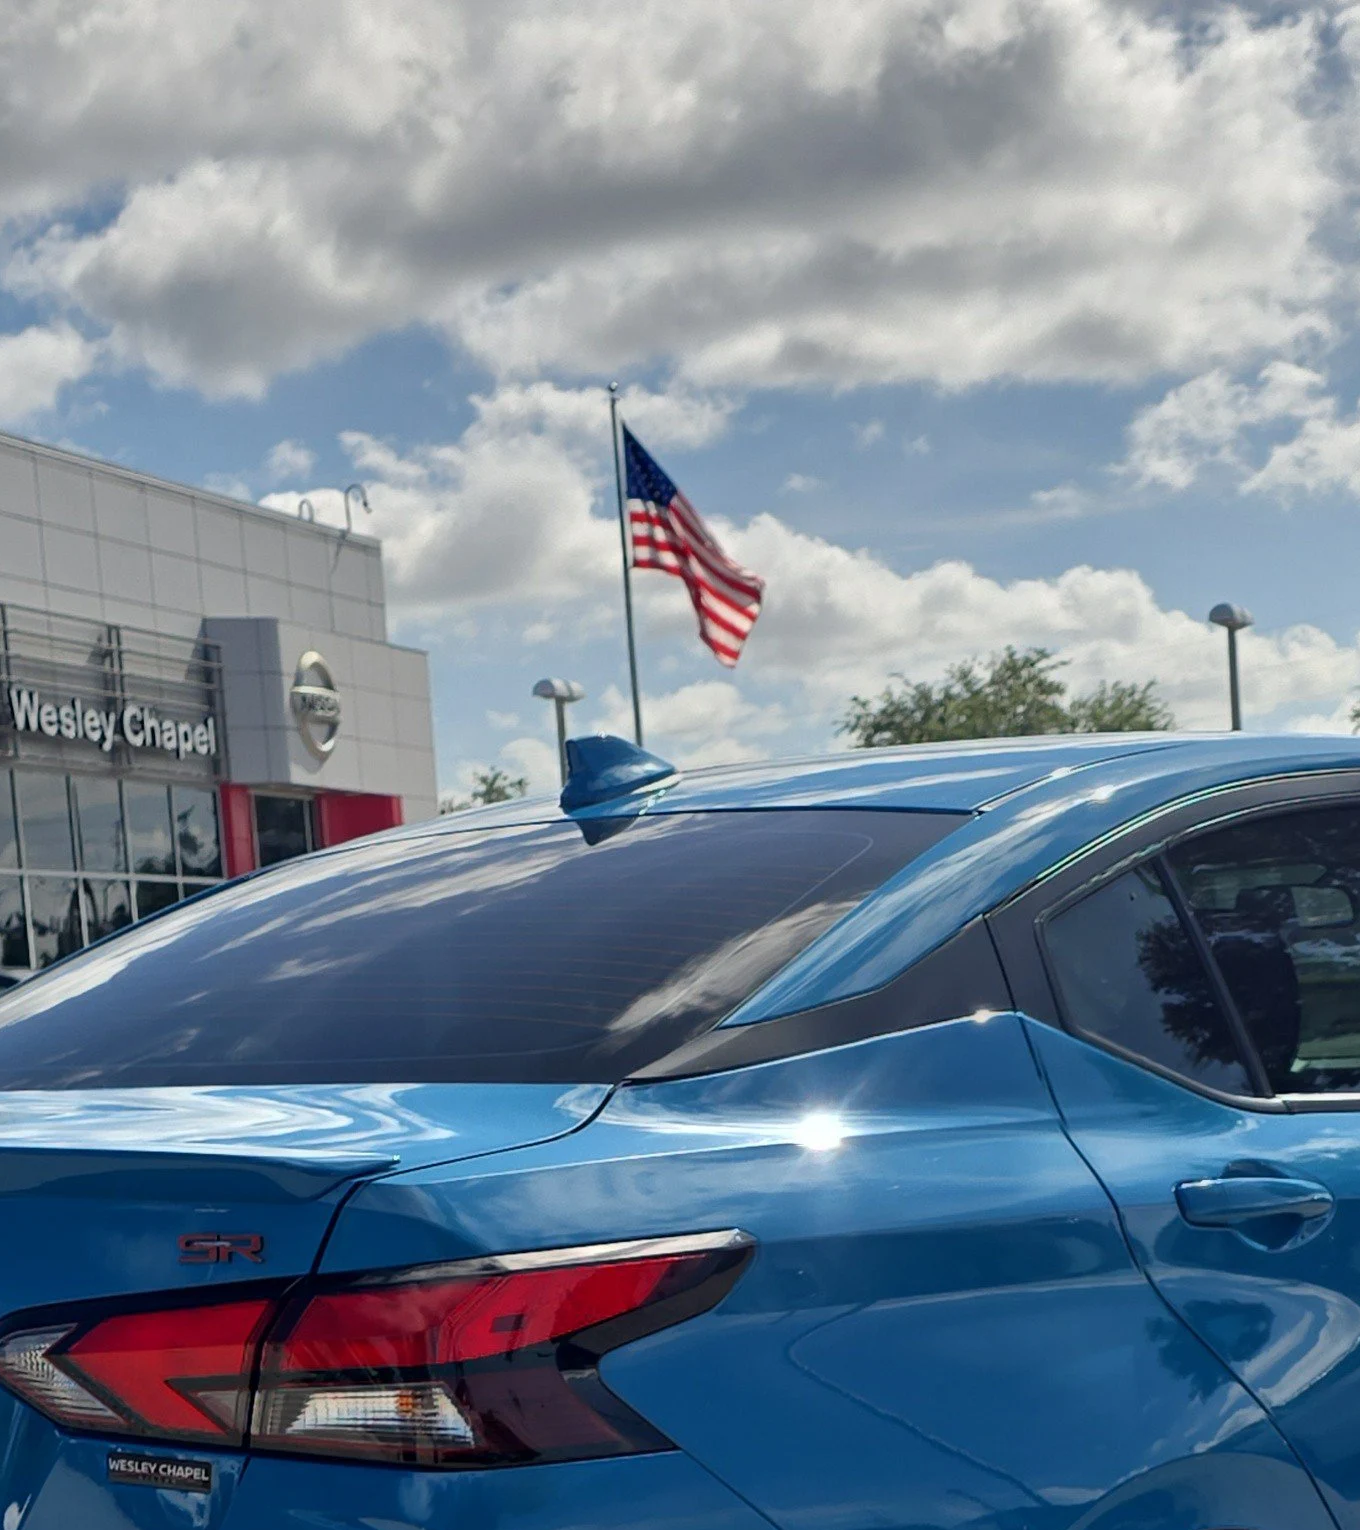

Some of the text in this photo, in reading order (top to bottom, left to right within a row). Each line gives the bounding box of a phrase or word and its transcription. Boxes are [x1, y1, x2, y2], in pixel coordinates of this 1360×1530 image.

[9, 685, 216, 761] Wesley Chapel
[178, 1233, 262, 1264] SR
[108, 1458, 157, 1474] WESLEY
[158, 1463, 210, 1481] CHAPEL
